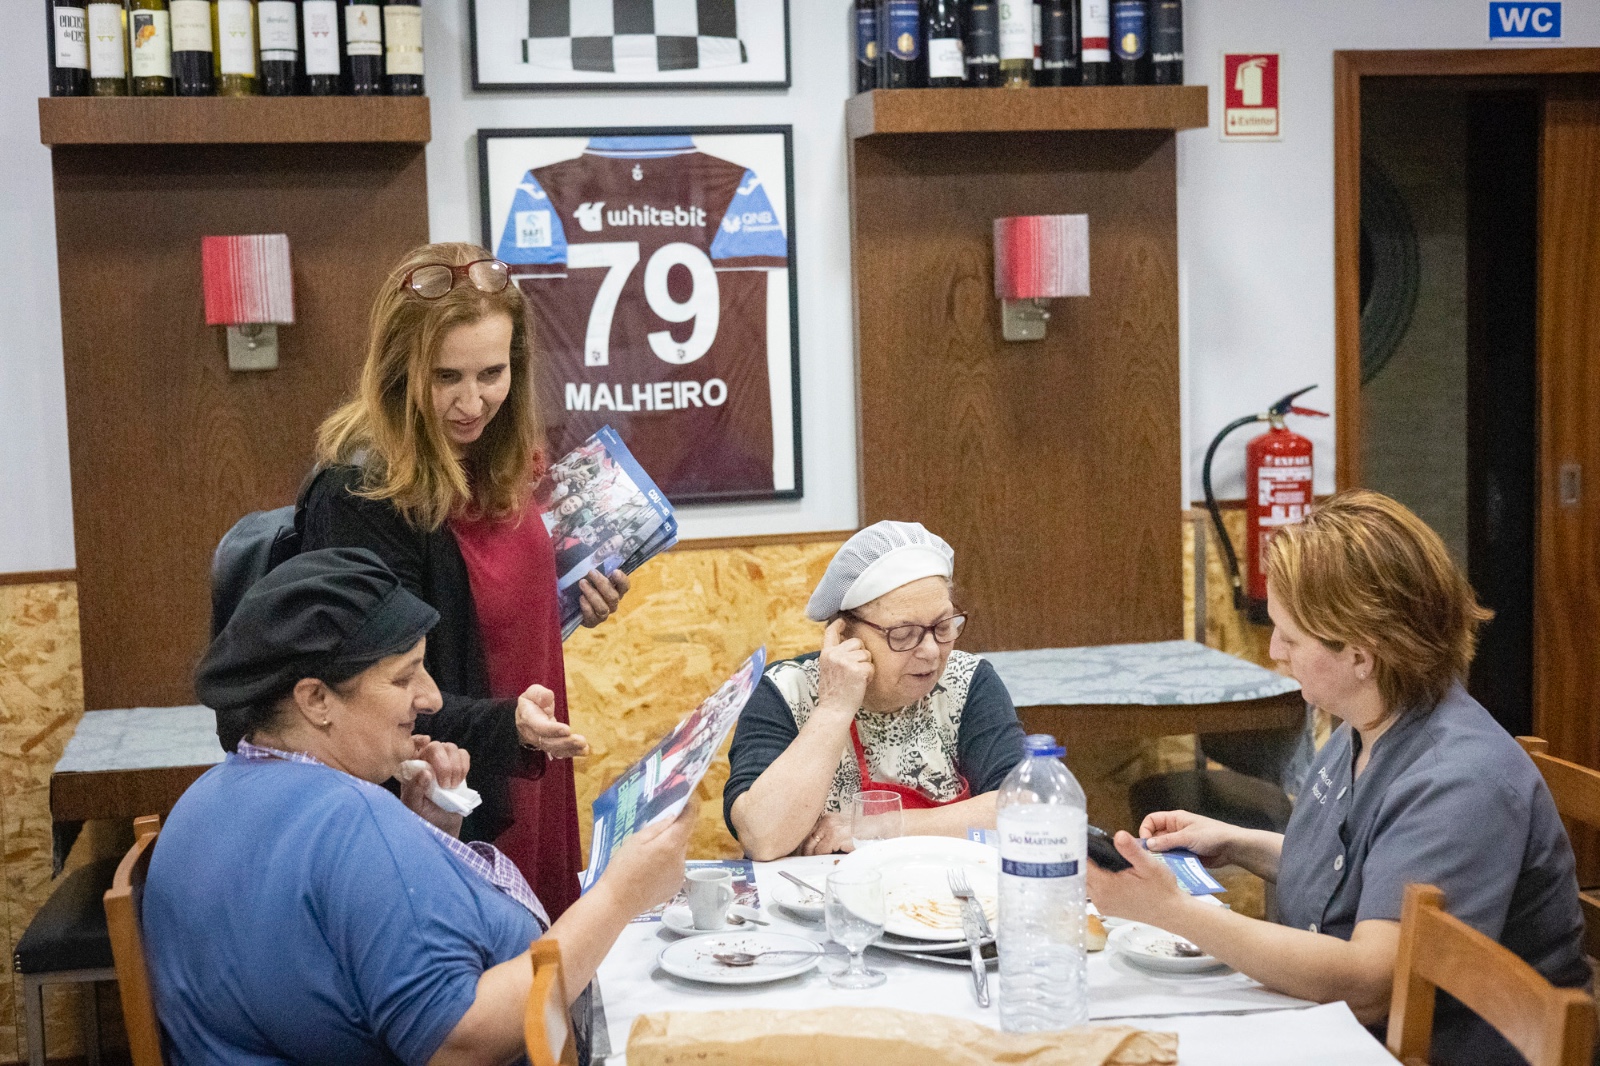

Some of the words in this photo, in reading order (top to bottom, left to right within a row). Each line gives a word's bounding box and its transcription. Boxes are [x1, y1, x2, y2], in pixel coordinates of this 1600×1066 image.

[1498, 7, 1553, 32] WC
[607, 204, 707, 227] whitebit
[567, 241, 720, 366] 79
[565, 378, 728, 411] MALHEIRO
